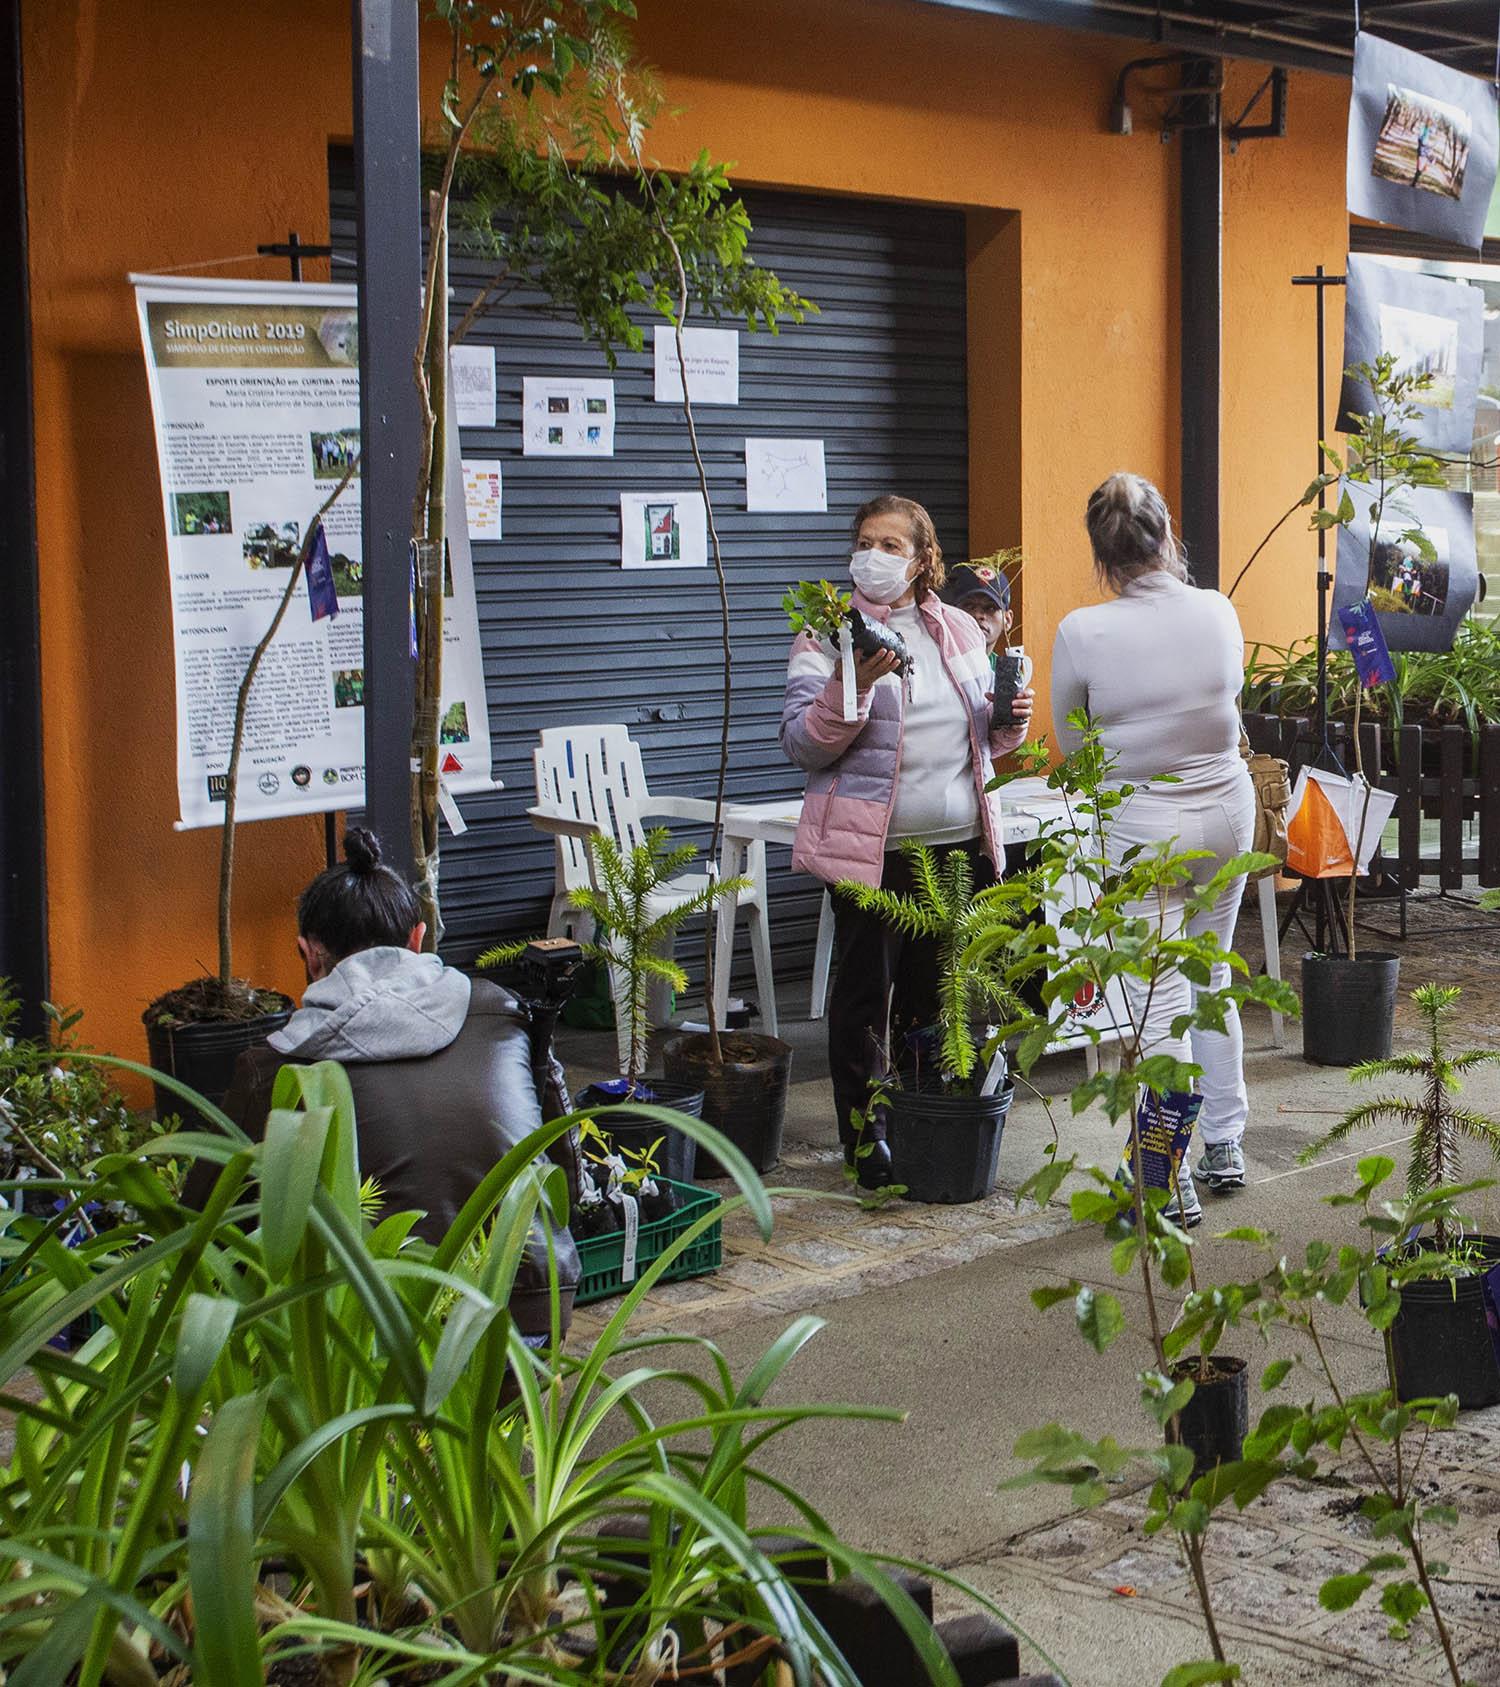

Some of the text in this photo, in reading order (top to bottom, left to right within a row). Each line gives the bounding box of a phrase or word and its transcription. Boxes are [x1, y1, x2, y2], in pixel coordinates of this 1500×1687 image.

[164, 320, 305, 343] SimpOrient 2019
[342, 379, 359, 387] PARA
